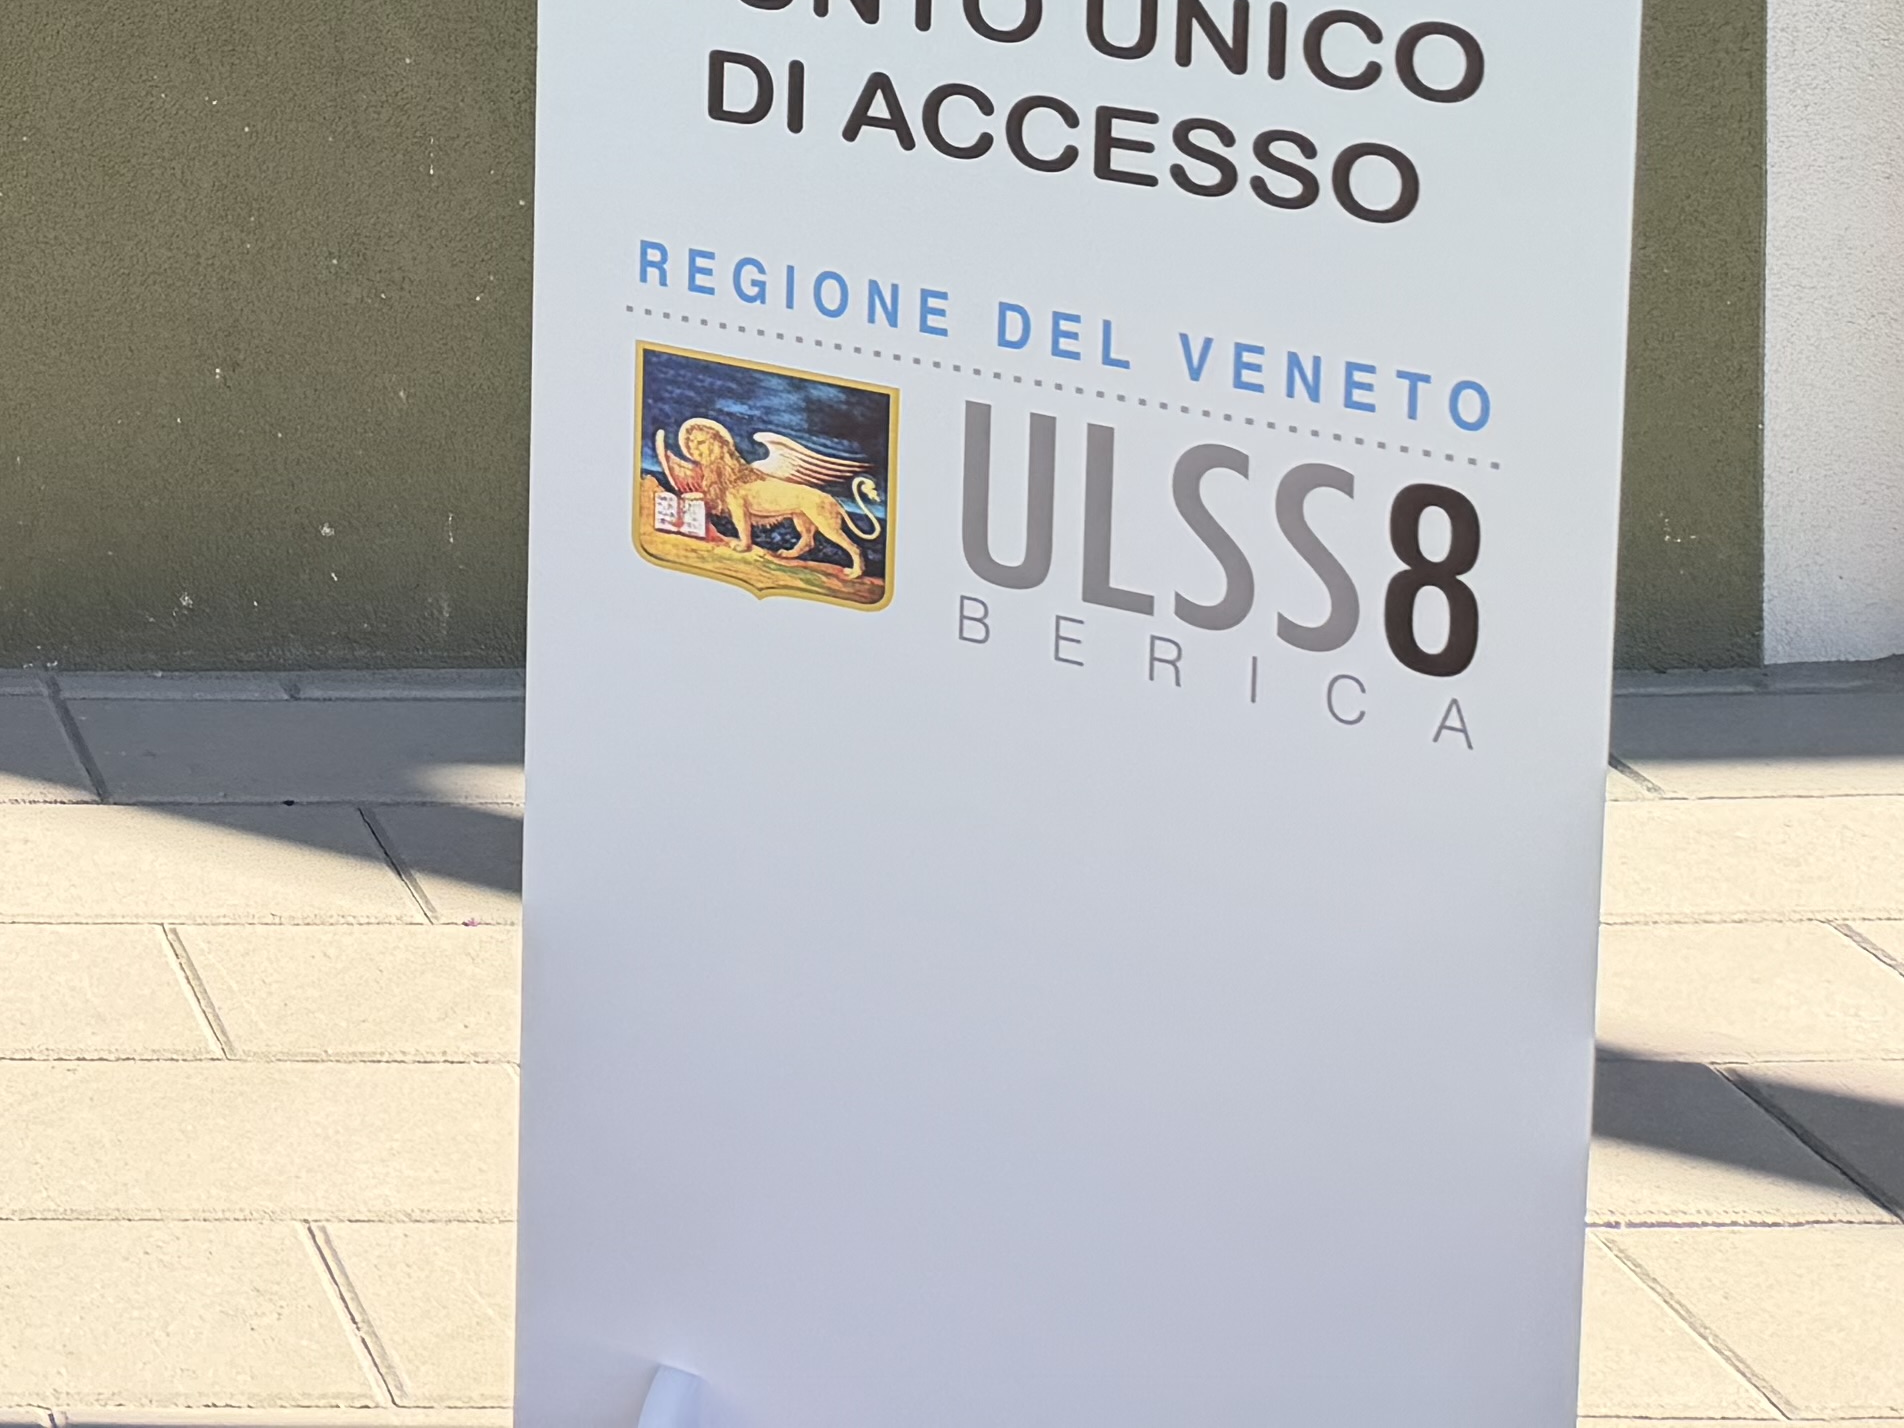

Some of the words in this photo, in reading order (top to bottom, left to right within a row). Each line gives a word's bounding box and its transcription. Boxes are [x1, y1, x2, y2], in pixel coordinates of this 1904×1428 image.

[705, 48, 806, 135] DI
[840, 70, 1422, 225] ACCESSO
[638, 238, 951, 339] REGIONE
[996, 300, 1132, 371] DEL
[1178, 332, 1494, 434] VENETO
[960, 399, 1482, 678] ULSS8
[956, 594, 1476, 752] BERICA
